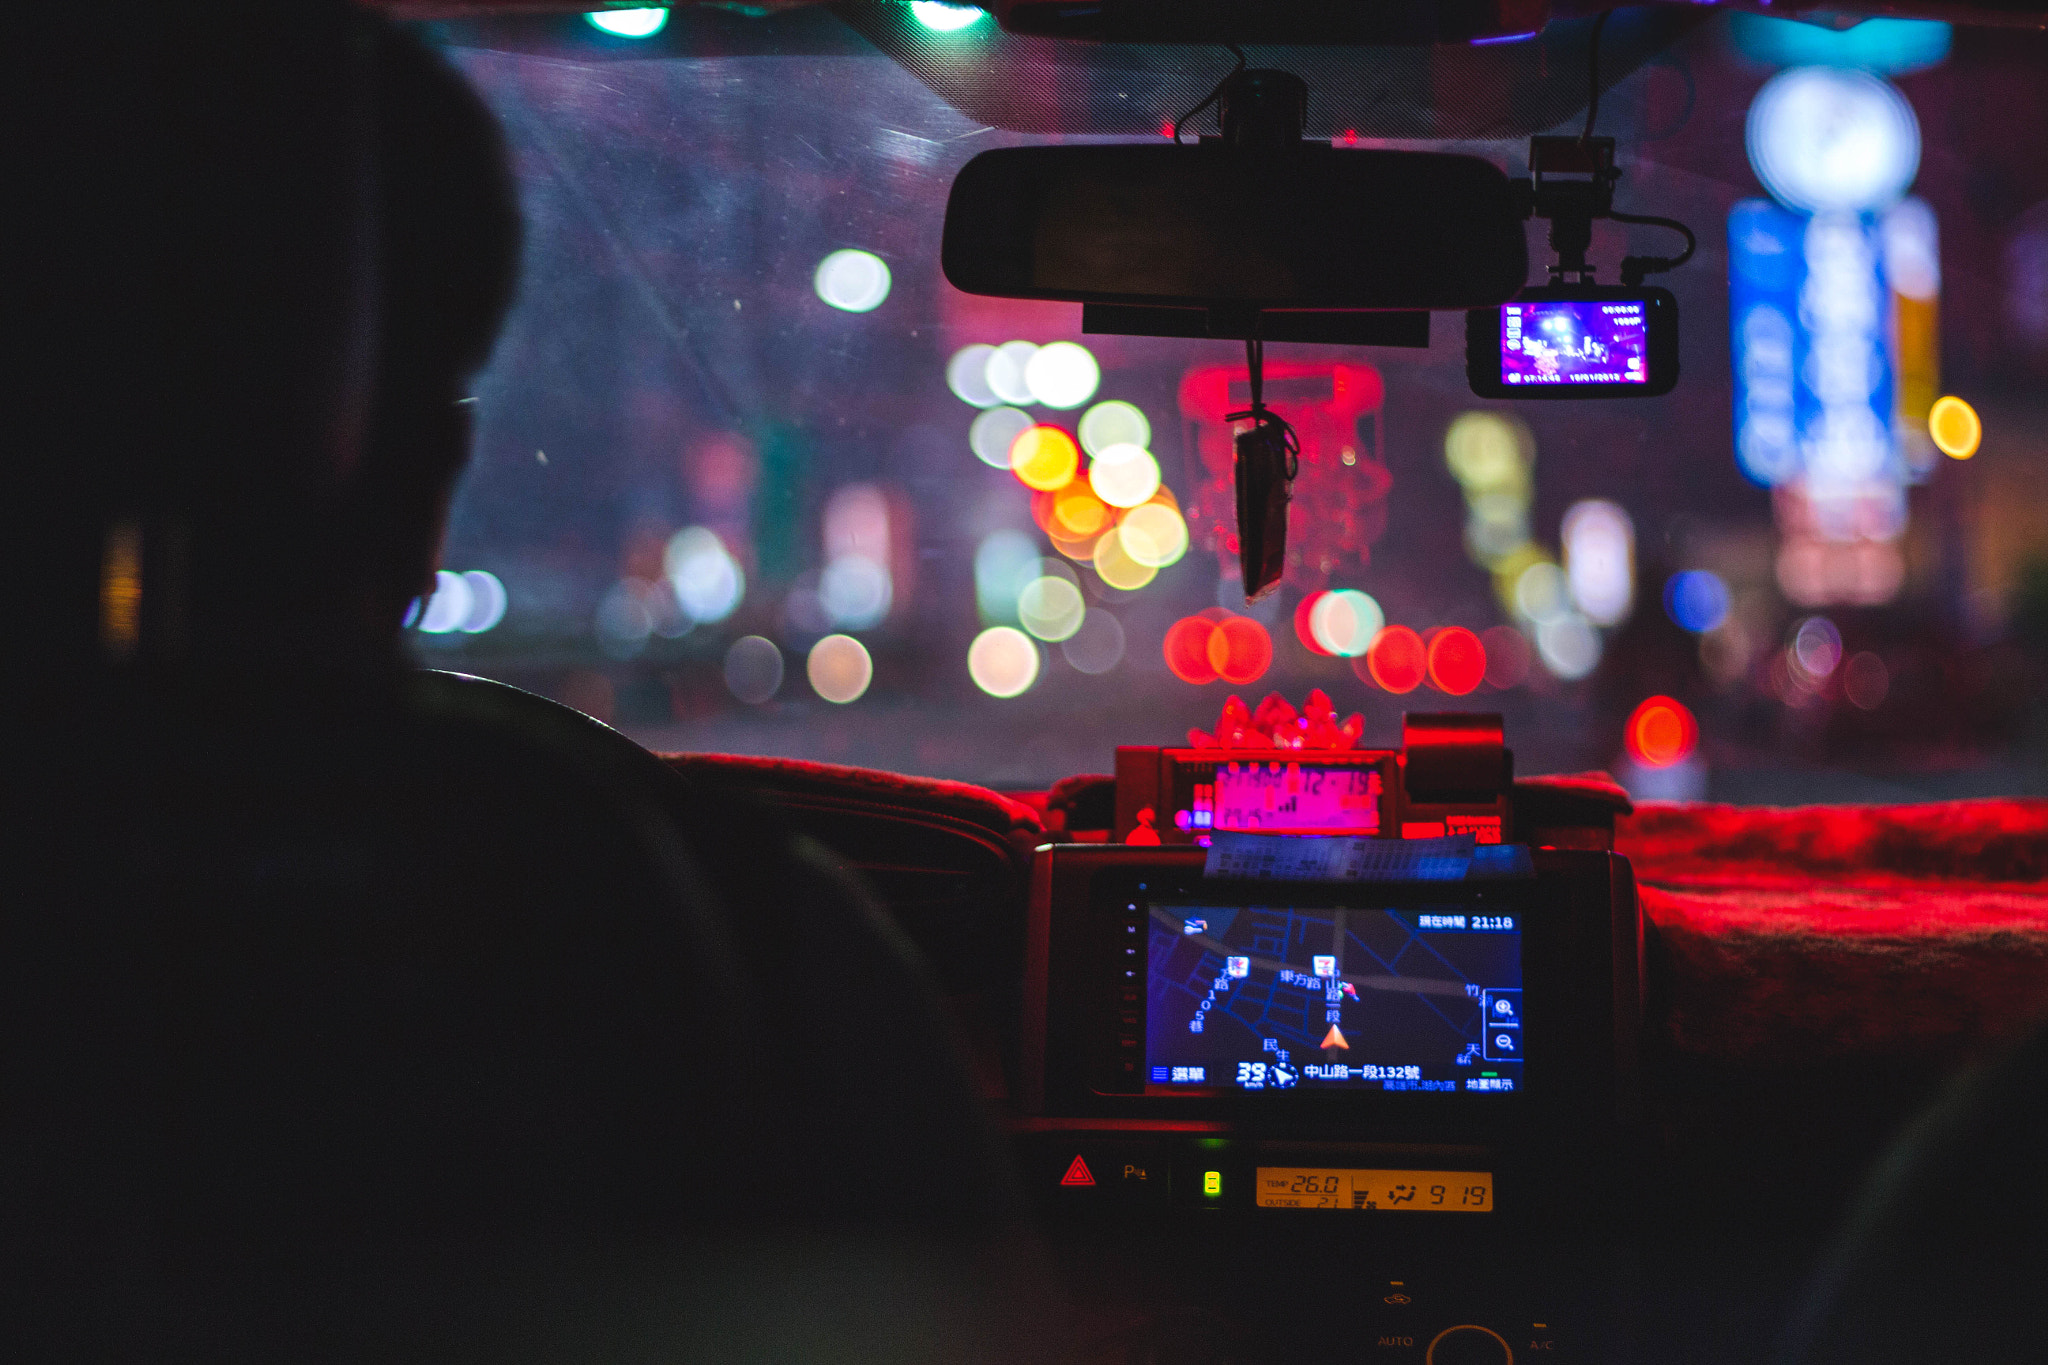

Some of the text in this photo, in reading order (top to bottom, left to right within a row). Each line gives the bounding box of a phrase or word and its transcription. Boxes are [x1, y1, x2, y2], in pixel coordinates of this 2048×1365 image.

[1418, 914, 1514, 930] 現在時間 21:18
[1280, 970, 1322, 990] 東方路
[1263, 1038, 1291, 1063] 民生
[1171, 1066, 1206, 1082] 選單
[1236, 1062, 1267, 1082] 39
[1304, 1064, 1421, 1080] 中山路一段132號
[1267, 1175, 1339, 1193] TEMP 26.0
[1378, 1336, 1413, 1346] AUTO
[1529, 1340, 1553, 1350] A/C
